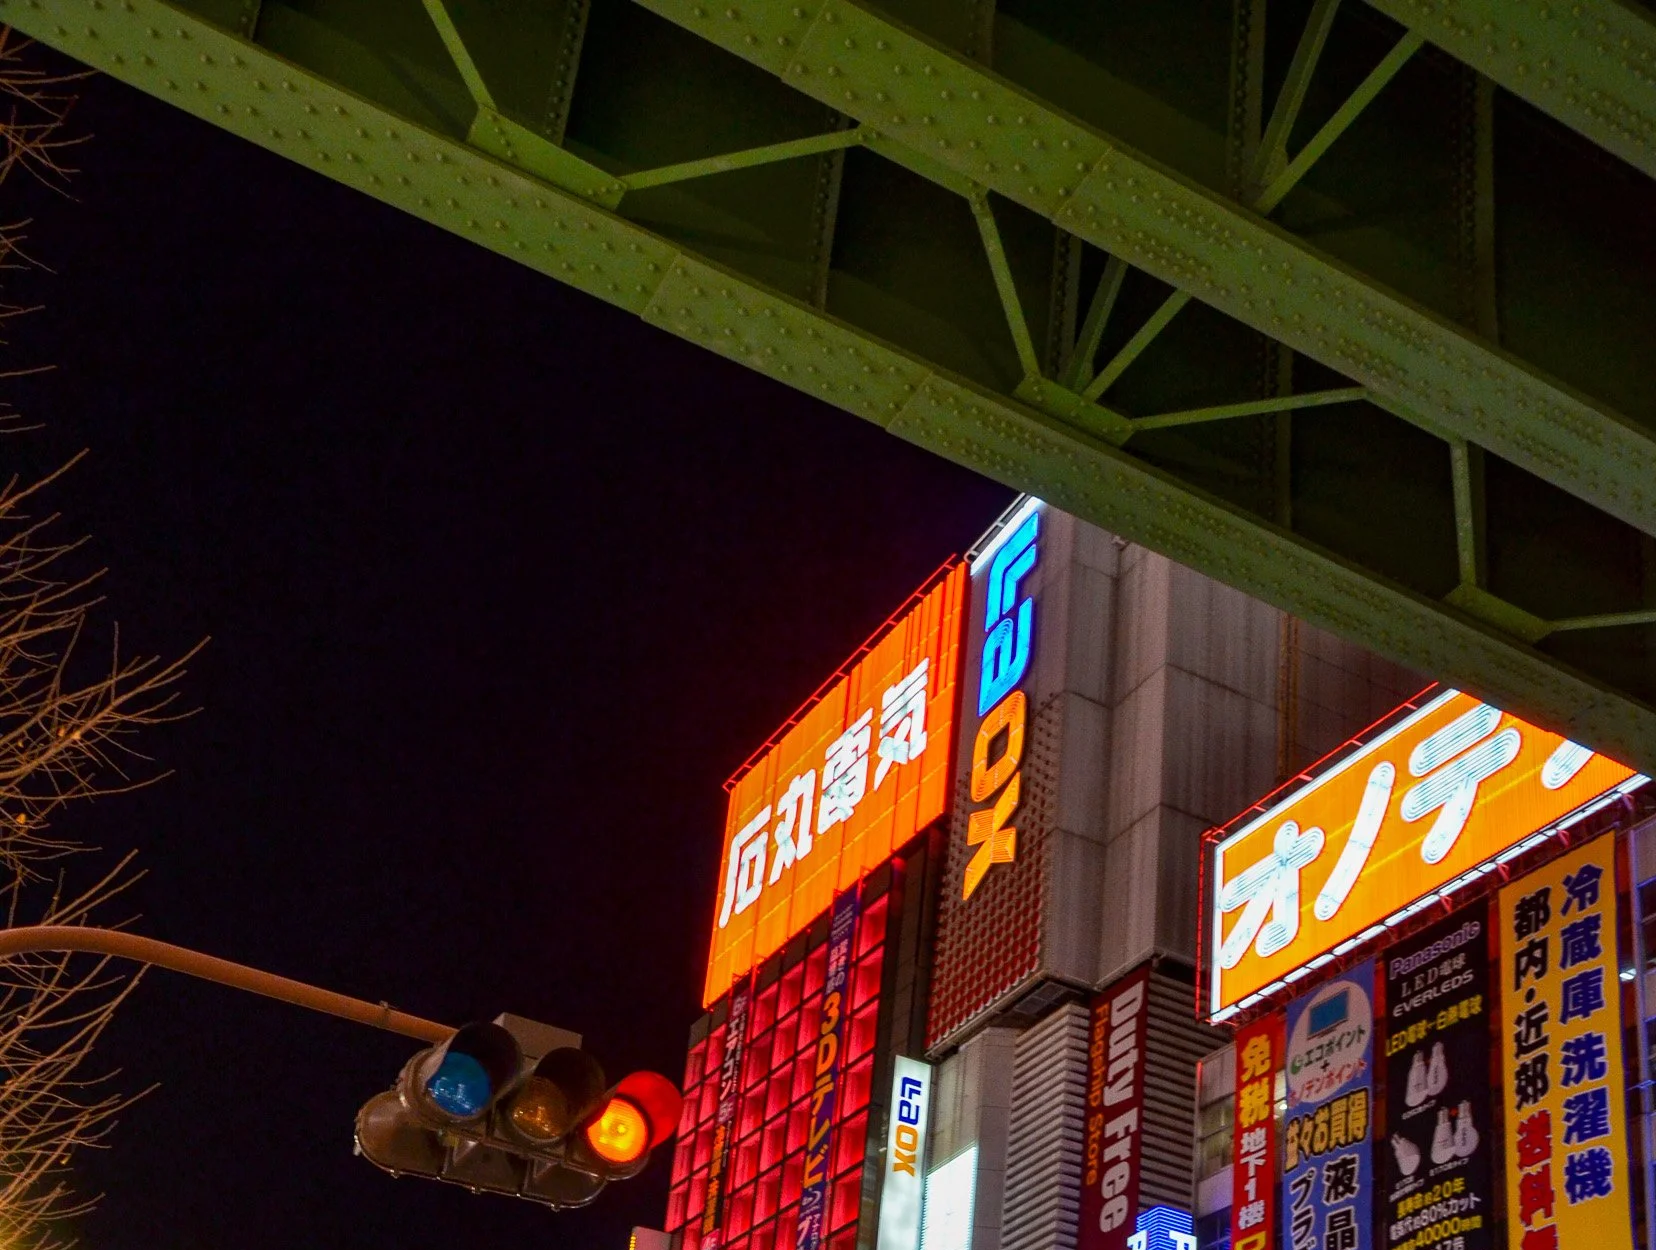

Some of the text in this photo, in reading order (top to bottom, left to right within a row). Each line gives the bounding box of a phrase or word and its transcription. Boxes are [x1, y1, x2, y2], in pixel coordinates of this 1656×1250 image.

[718, 657, 930, 929] 石丸電気
[1389, 920, 1481, 980] Panasonic
[1393, 969, 1475, 1018] EVERLEDS
[1100, 980, 1144, 1233] Duty Free
[1239, 1033, 1271, 1129] 免税
